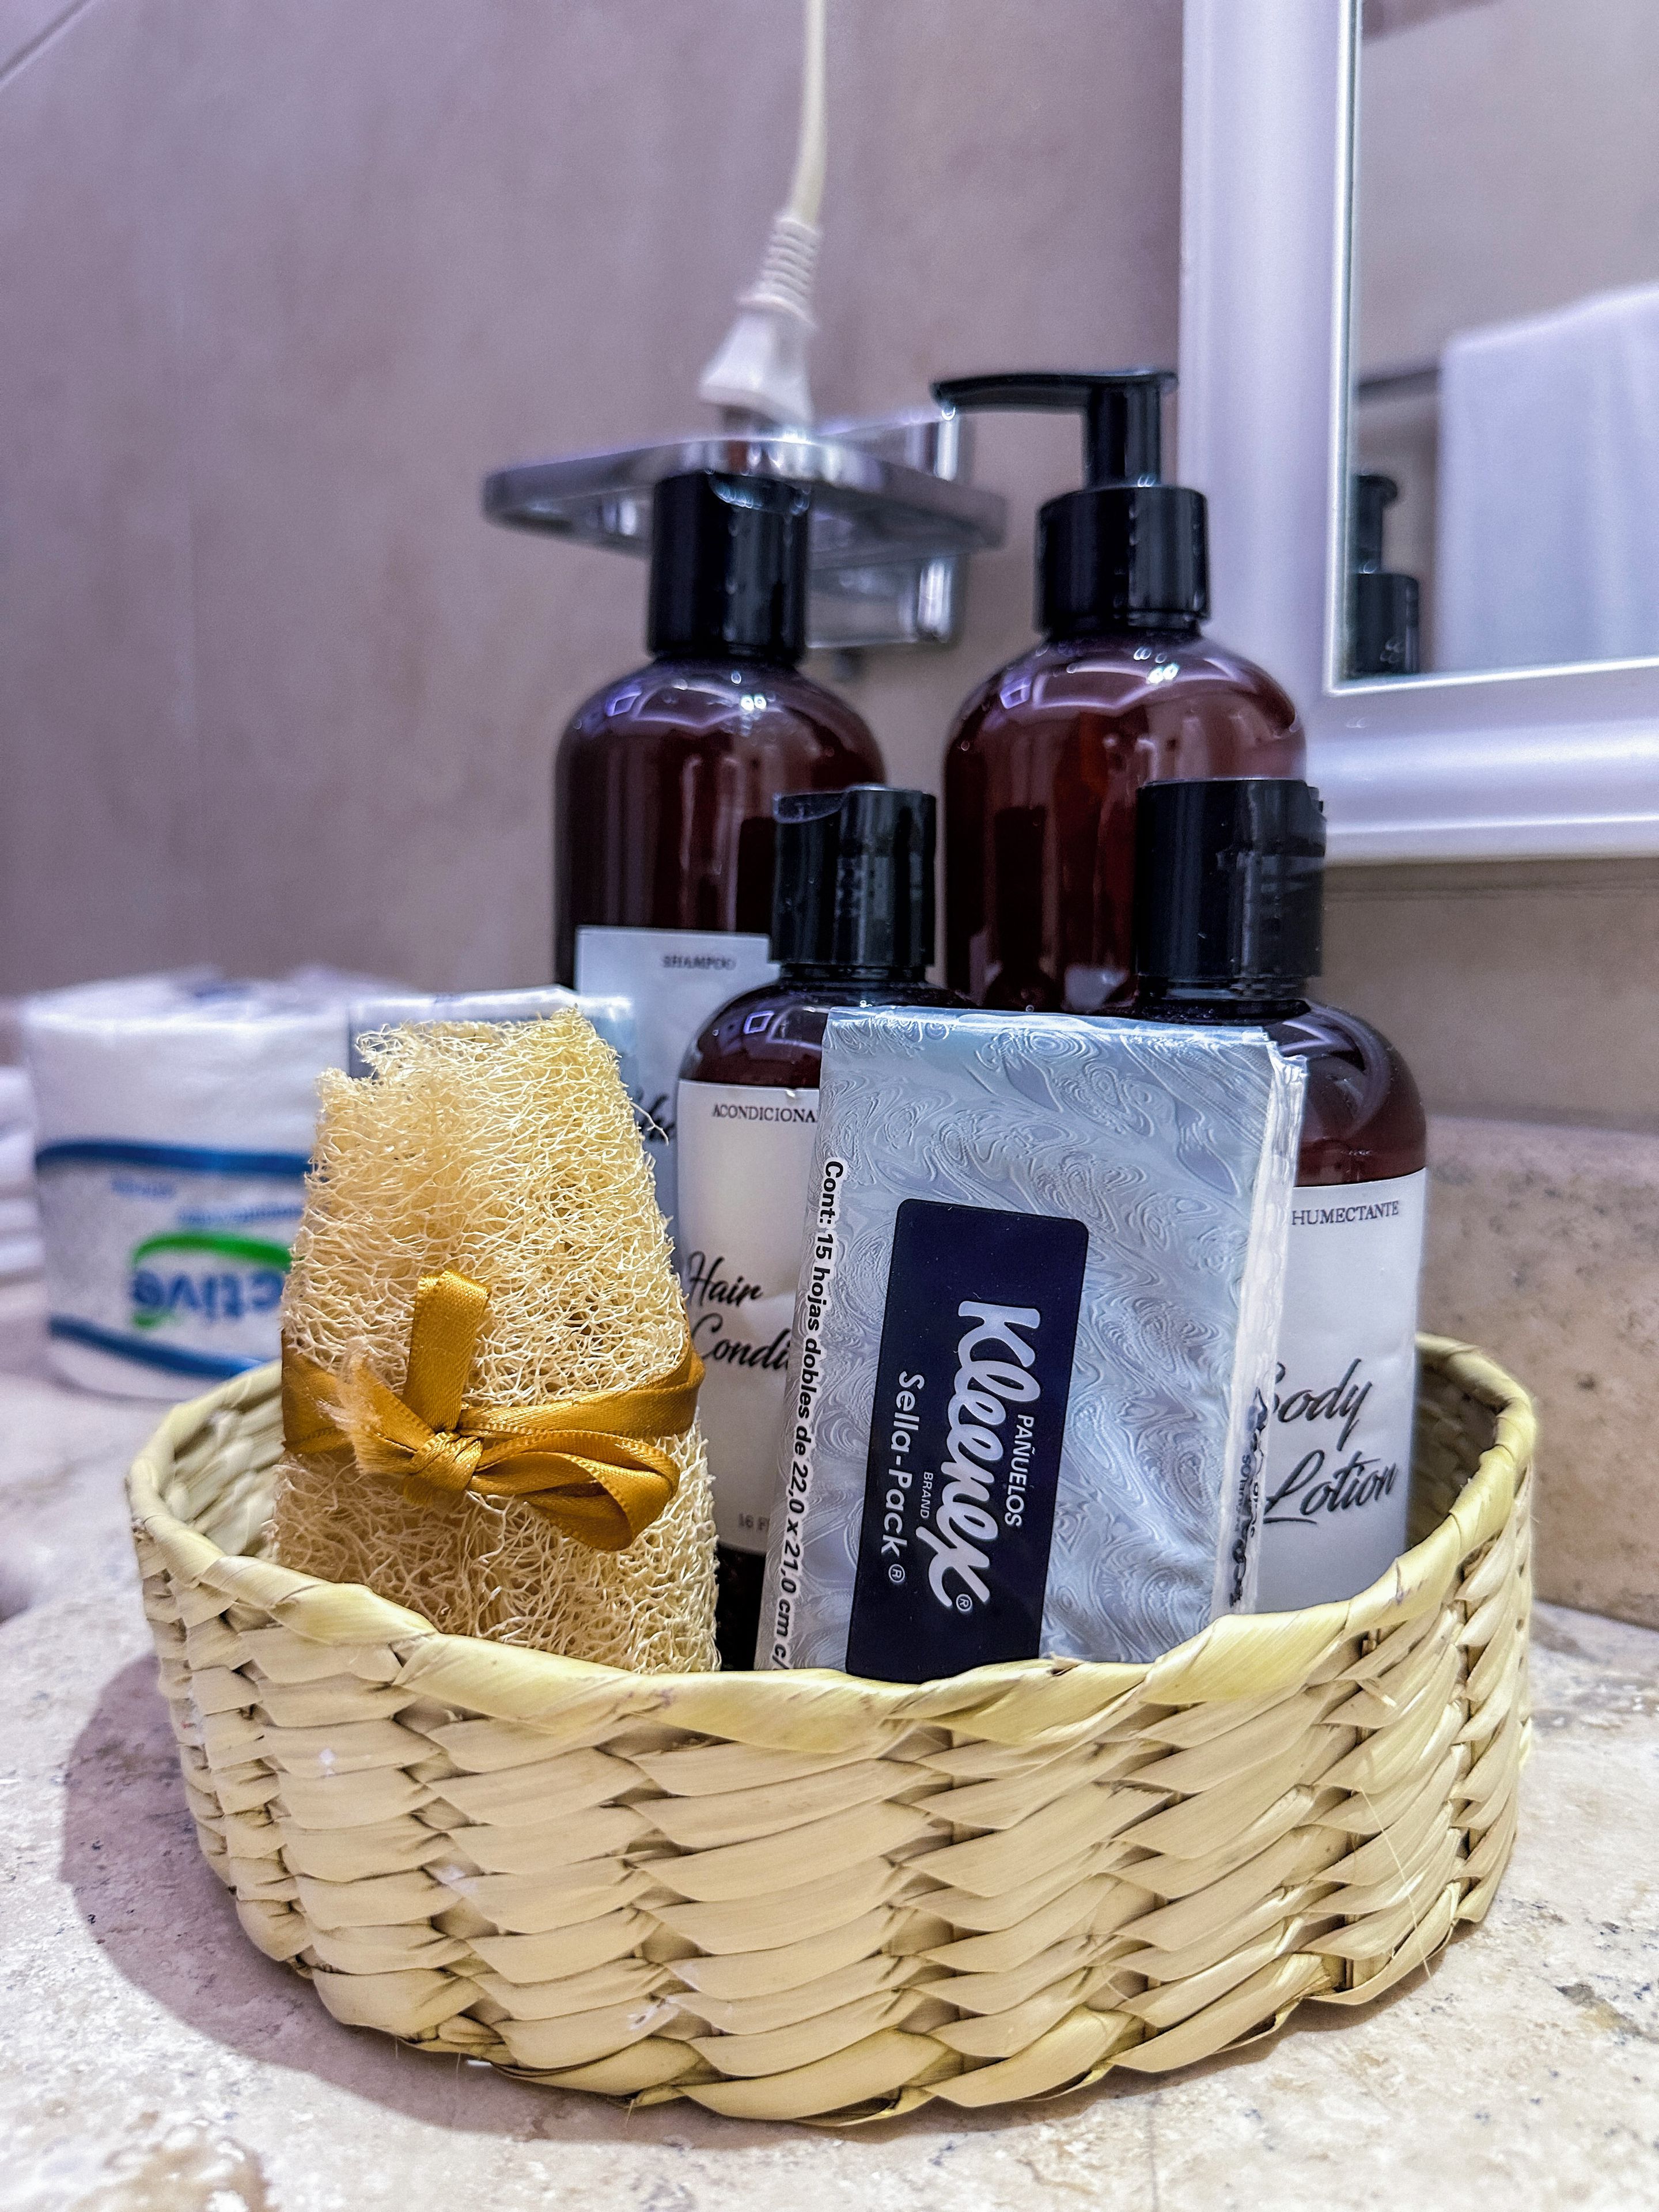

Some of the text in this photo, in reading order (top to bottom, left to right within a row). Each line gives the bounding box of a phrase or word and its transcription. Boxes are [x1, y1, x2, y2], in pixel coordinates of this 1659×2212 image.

[662, 955, 737, 971] SHAMPOO
[819, 1161, 844, 1225] Cont:
[1291, 1200, 1399, 1225] HUMECTANTE
[816, 1233, 834, 1260] 15
[688, 1251, 763, 1306] Hair
[808, 1266, 831, 1332] hojas
[798, 1338, 821, 1419] dobles
[794, 1425, 812, 1456] de
[880, 1370, 925, 1558] Sella-Pack
[788, 1461, 808, 1514] 22,0
[920, 1471, 934, 1519] BRAND
[1004, 1414, 1036, 1527] PAÑUELOS
[1263, 1448, 1397, 1525] Lotion
[787, 1517, 798, 1536] x
[780, 1539, 801, 1594] 21,0
[777, 1598, 790, 1637] cm
